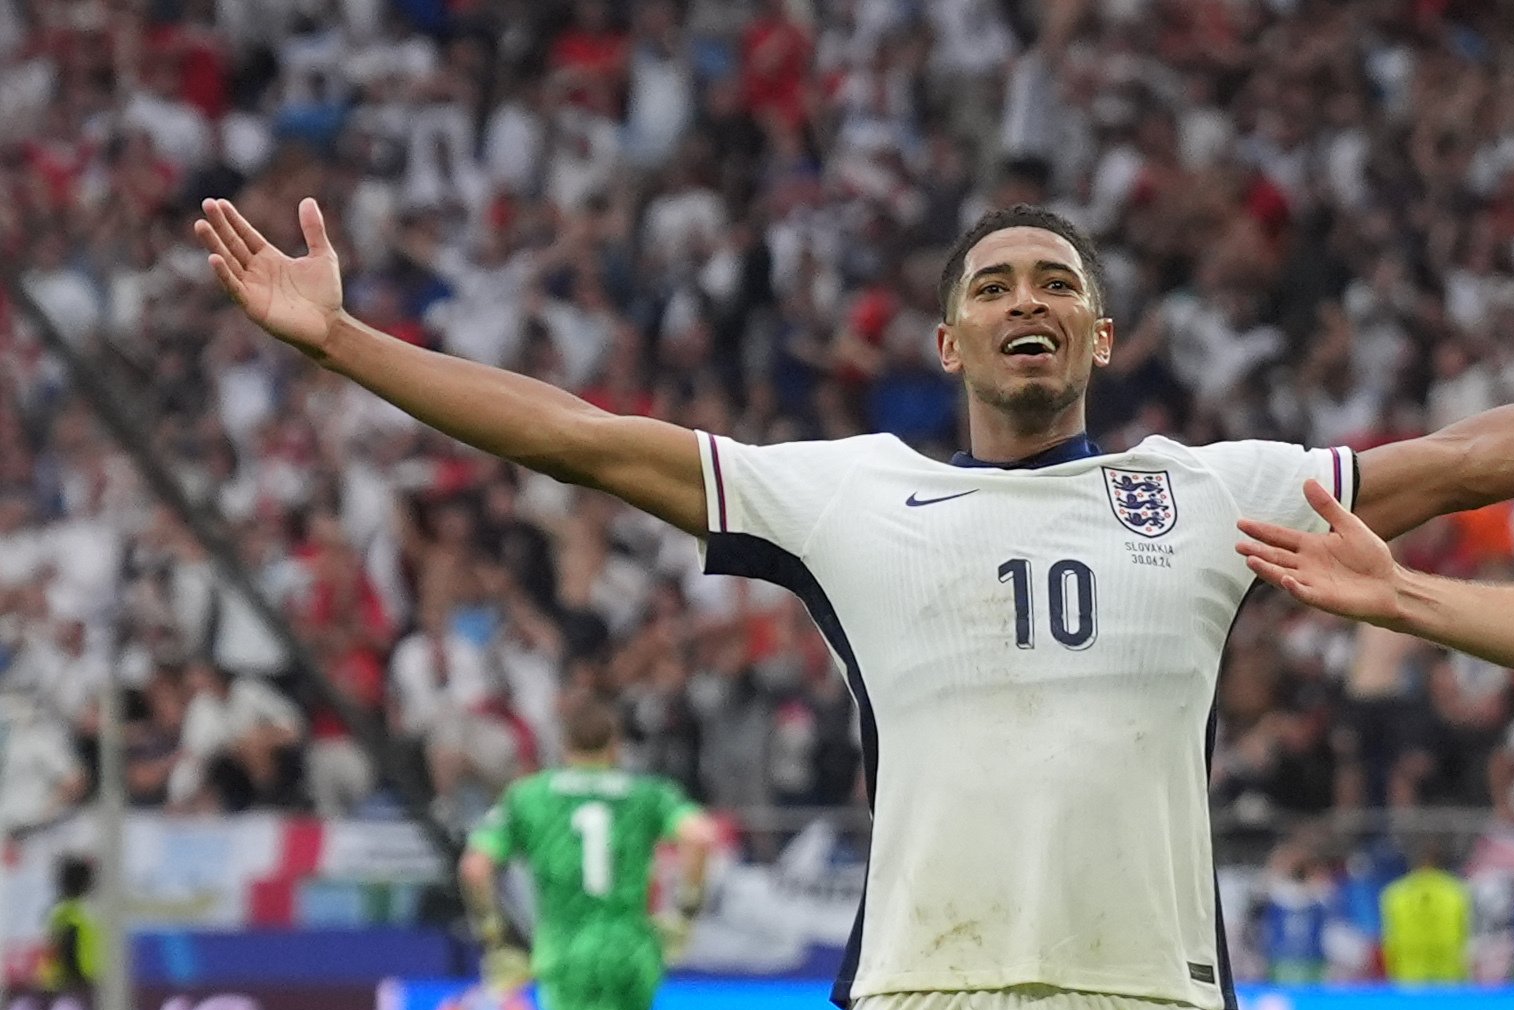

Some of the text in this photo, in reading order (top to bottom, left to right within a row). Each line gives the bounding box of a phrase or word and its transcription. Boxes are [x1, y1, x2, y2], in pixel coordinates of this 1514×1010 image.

[1125, 542, 1175, 554] SLOVAKIA
[1132, 554, 1172, 568] 30.06.24
[998, 558, 1098, 651] 10
[572, 801, 614, 896] 1
